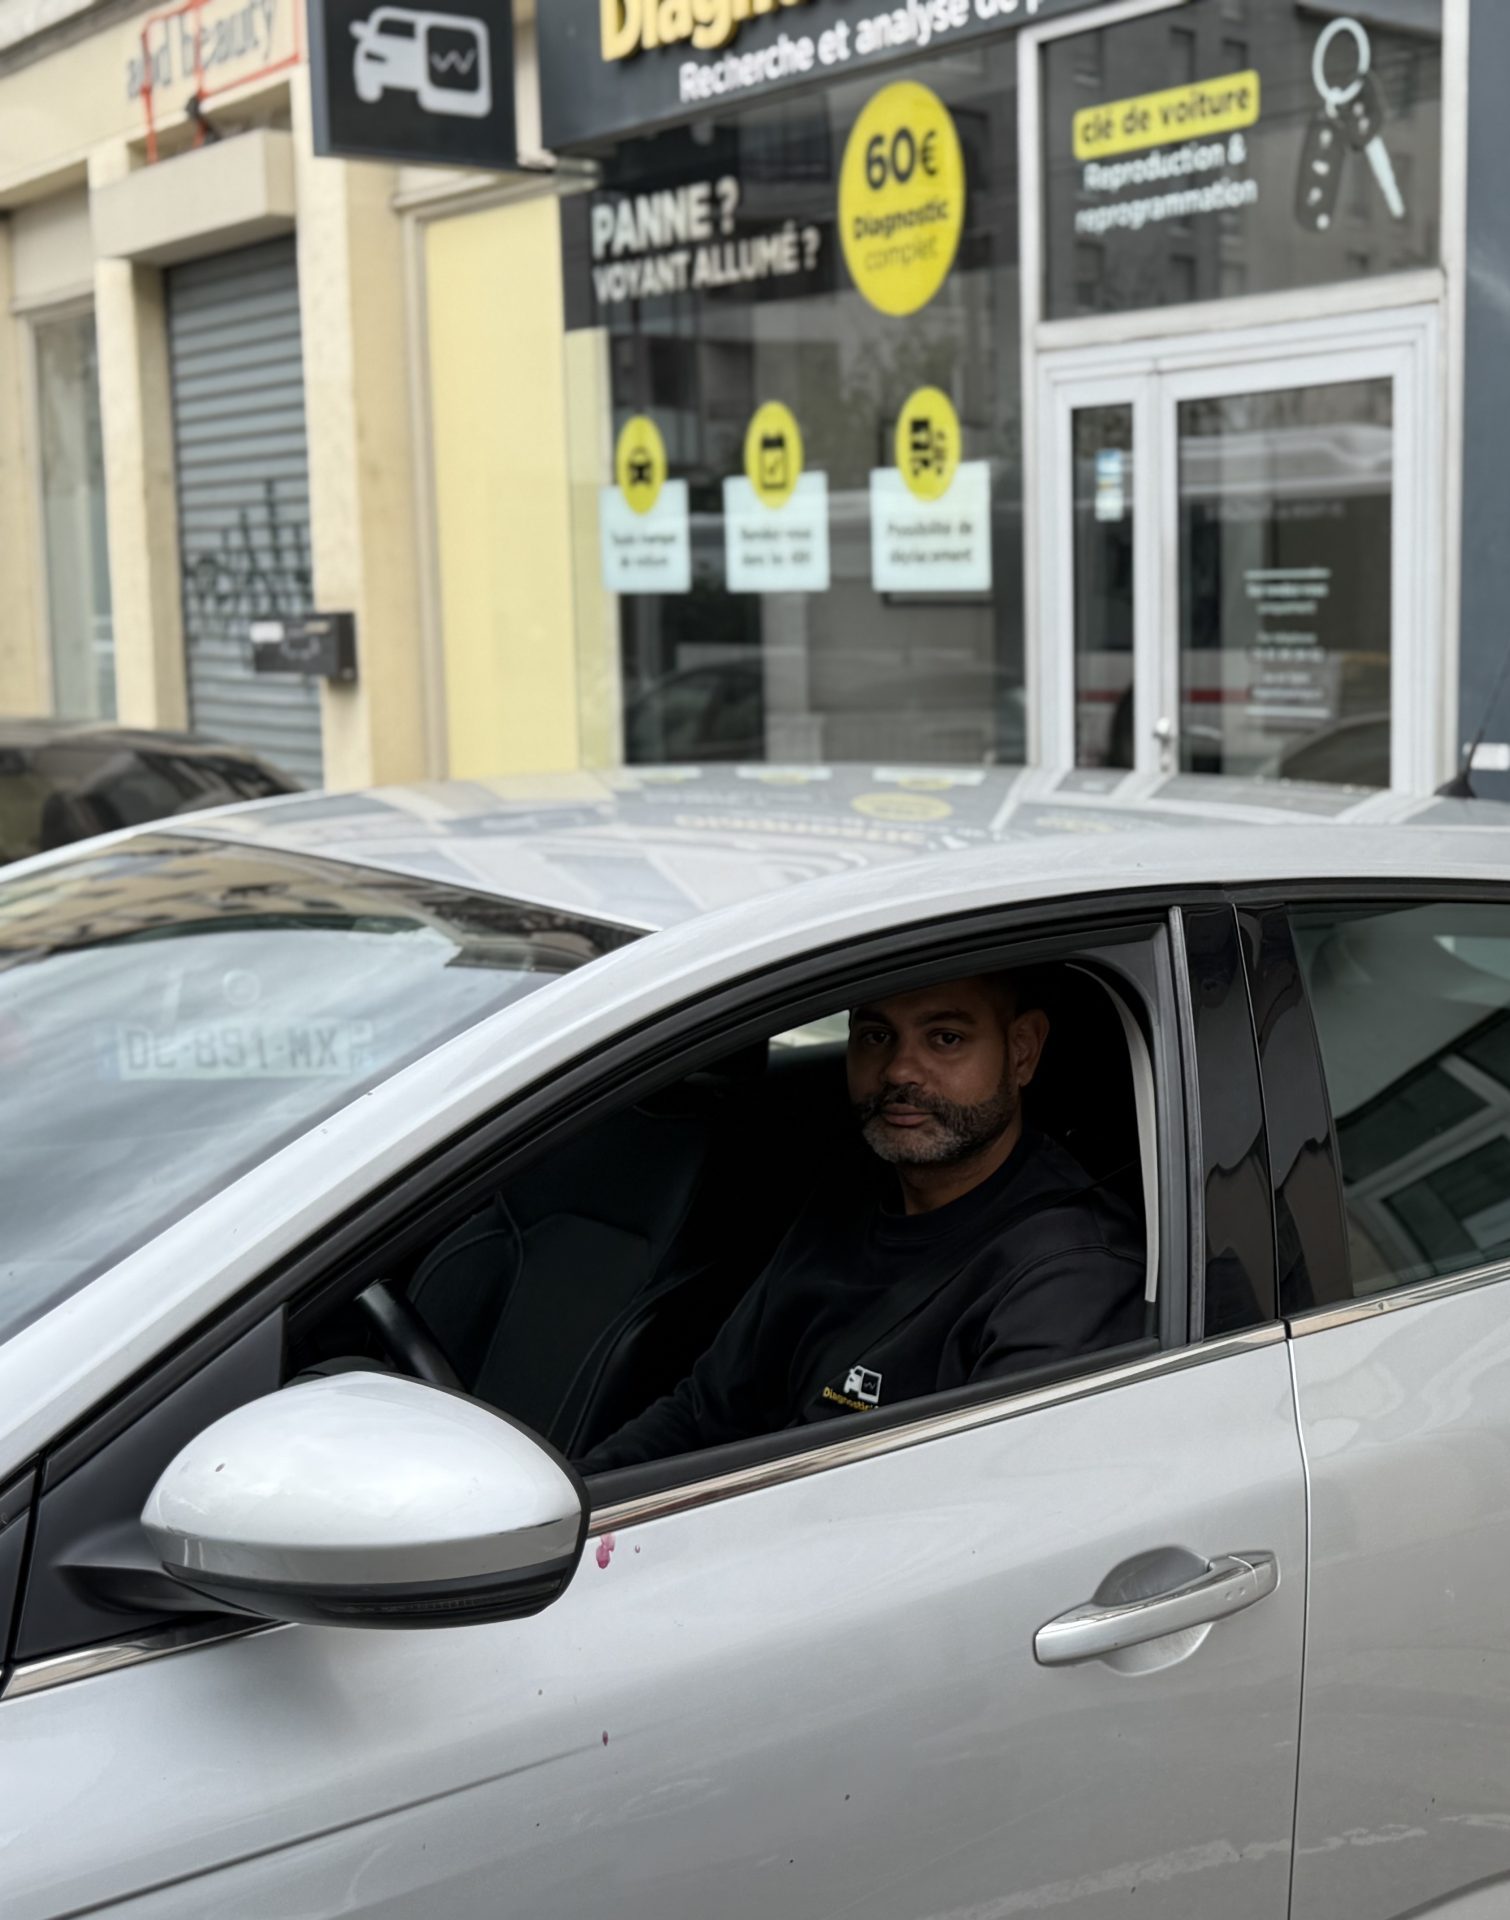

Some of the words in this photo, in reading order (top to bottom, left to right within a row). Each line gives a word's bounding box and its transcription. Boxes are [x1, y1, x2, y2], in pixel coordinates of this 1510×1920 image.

[678, 35, 815, 102] Recherche
[817, 19, 850, 66] et
[855, 0, 970, 54] analyse
[1080, 110, 1115, 145] clé
[1121, 103, 1149, 136] de
[1158, 87, 1250, 127] voiture
[865, 126, 939, 192] 60€
[1083, 141, 1226, 193] Reproduction
[1227, 132, 1247, 166] &
[591, 181, 713, 260] PANNE
[716, 175, 740, 236] ?
[853, 197, 949, 240] Diagnostic
[1074, 176, 1259, 236] reprogrammation
[593, 250, 690, 303] VOYANT
[692, 219, 799, 290] ALLUMÉ
[802, 226, 821, 270] ?
